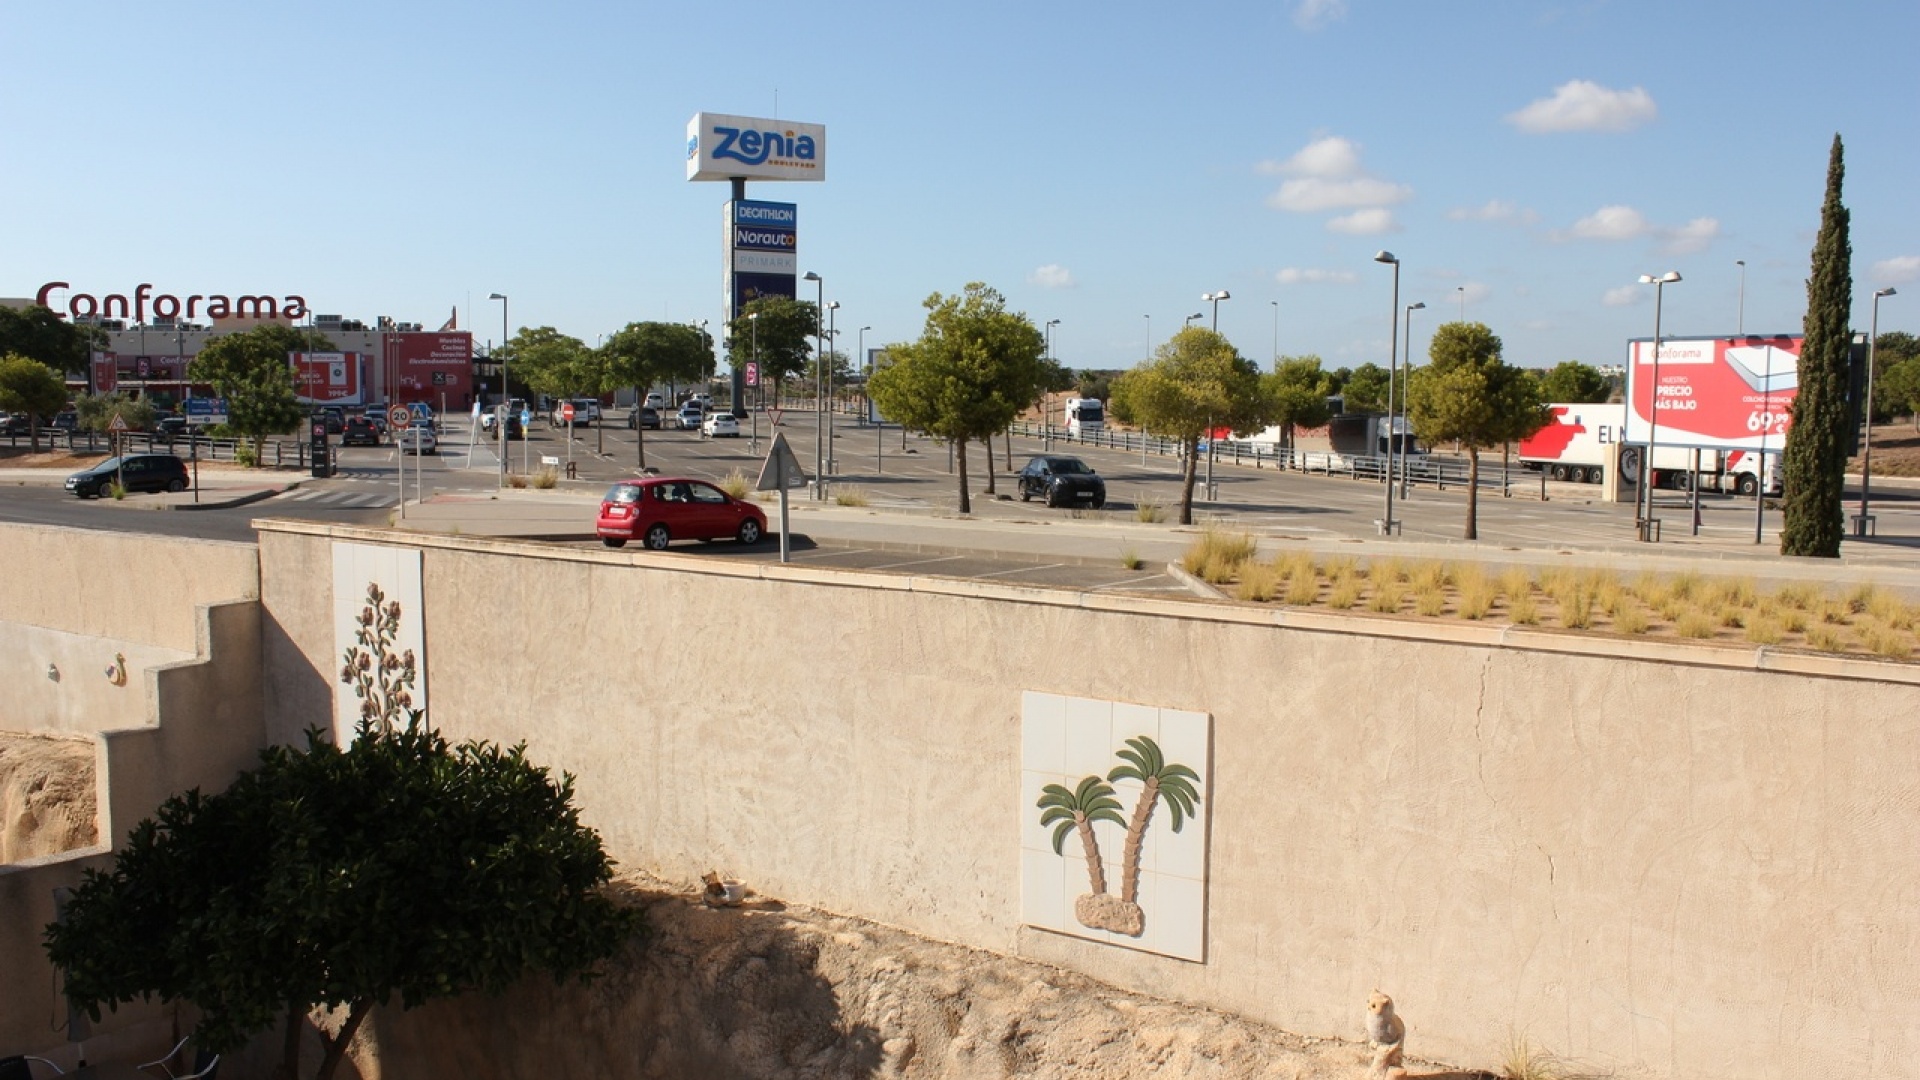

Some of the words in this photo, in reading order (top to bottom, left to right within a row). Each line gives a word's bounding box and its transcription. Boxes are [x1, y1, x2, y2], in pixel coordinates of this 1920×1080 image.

[739, 206, 793, 221] DECATHLON
[737, 230, 795, 246] Norauto
[740, 255, 792, 268] PRIMARK
[36, 282, 306, 322] Conforama
[1657, 386, 1693, 397] PRECIO
[1672, 399, 1697, 410] BAJO
[393, 411, 407, 421] 20
[1598, 425, 1616, 444] EL
